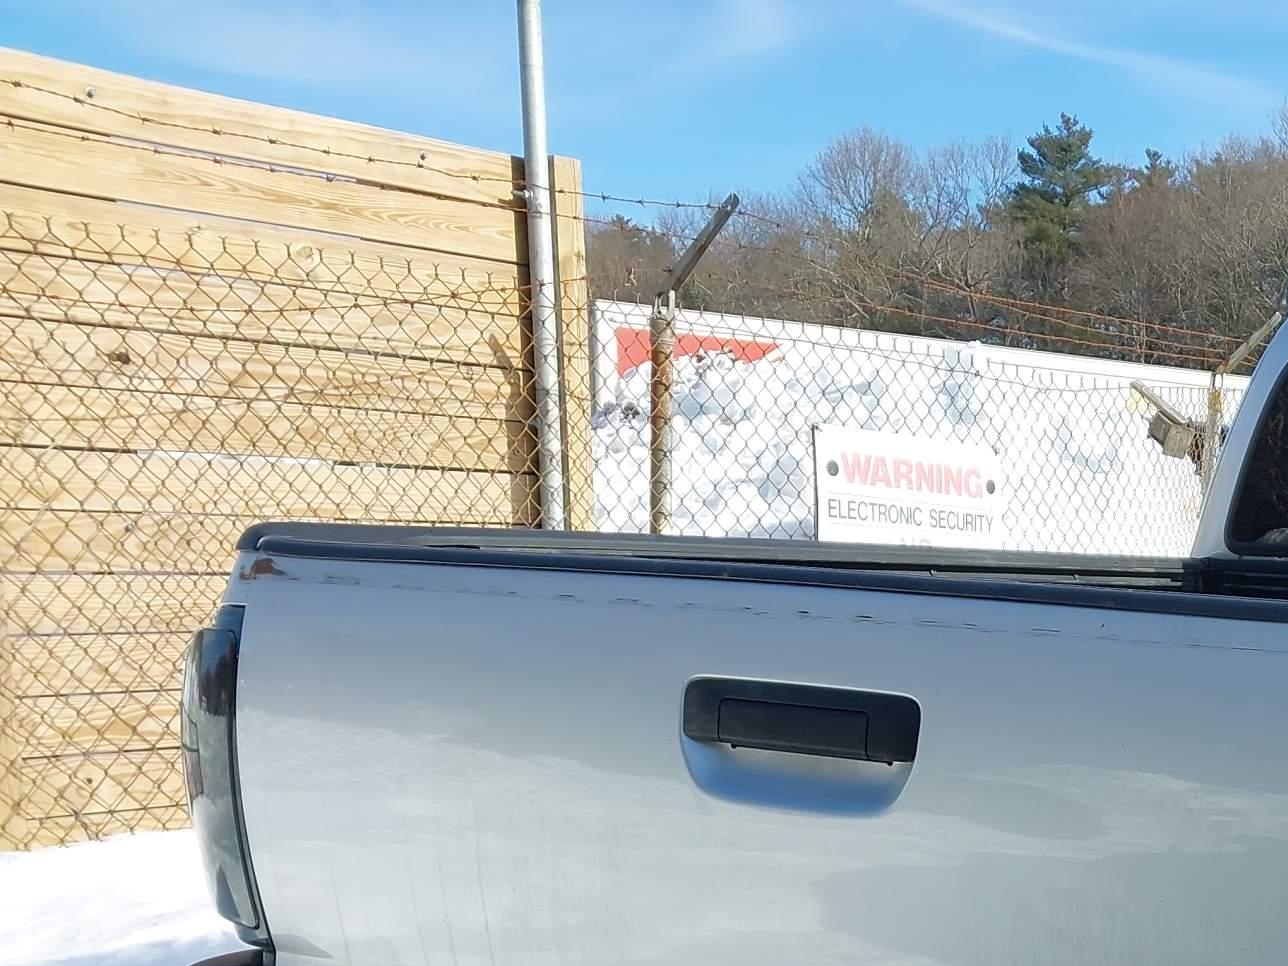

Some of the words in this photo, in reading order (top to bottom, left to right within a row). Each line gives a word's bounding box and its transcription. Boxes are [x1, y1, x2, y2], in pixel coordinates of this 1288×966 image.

[840, 451, 983, 498] WARNING
[827, 498, 923, 526] ELECTRONIC
[929, 508, 994, 533] SECURITY
